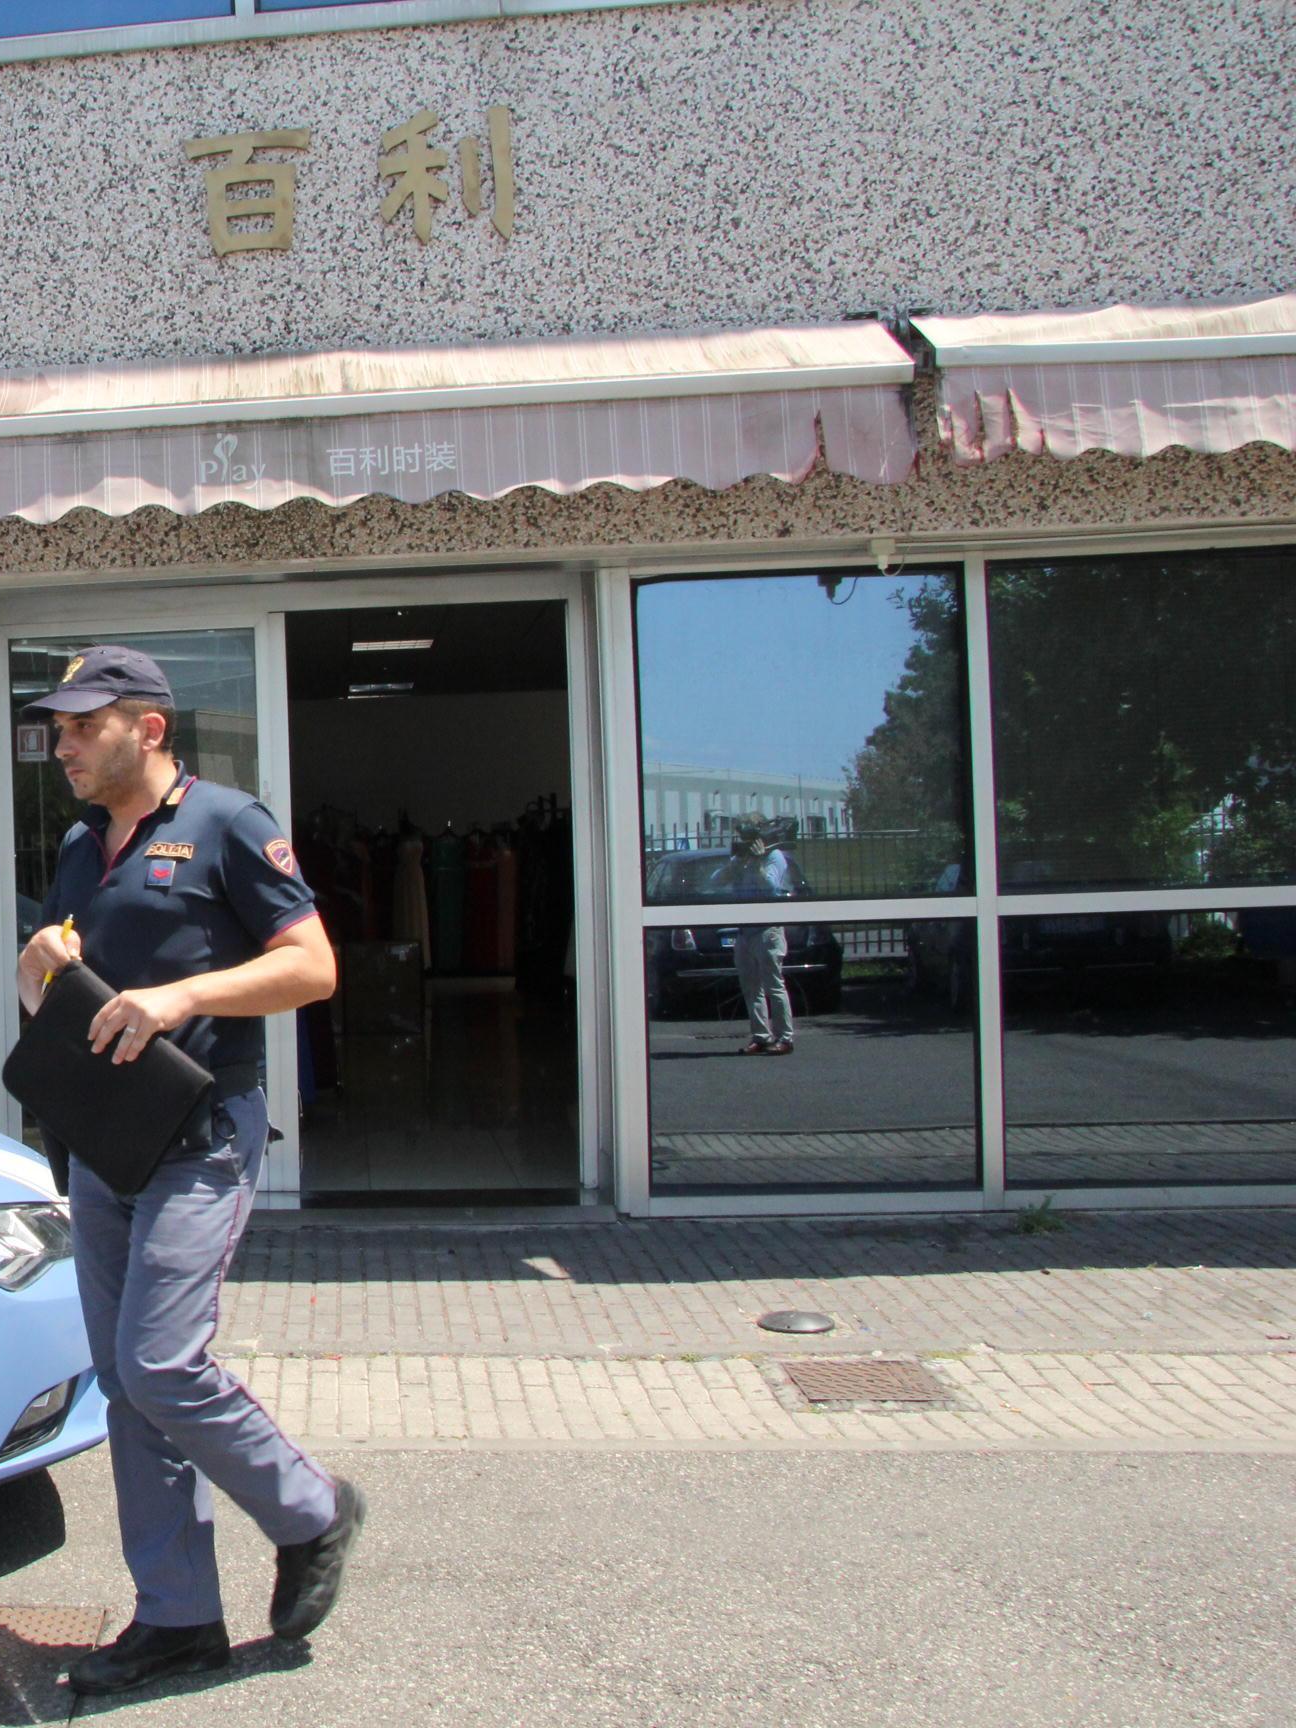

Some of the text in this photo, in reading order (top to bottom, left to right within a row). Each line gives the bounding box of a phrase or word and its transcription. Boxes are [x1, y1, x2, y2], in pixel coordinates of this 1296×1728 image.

[183, 105, 515, 257] 百利
[200, 433, 266, 490] Play
[326, 441, 456, 477] 百利时装
